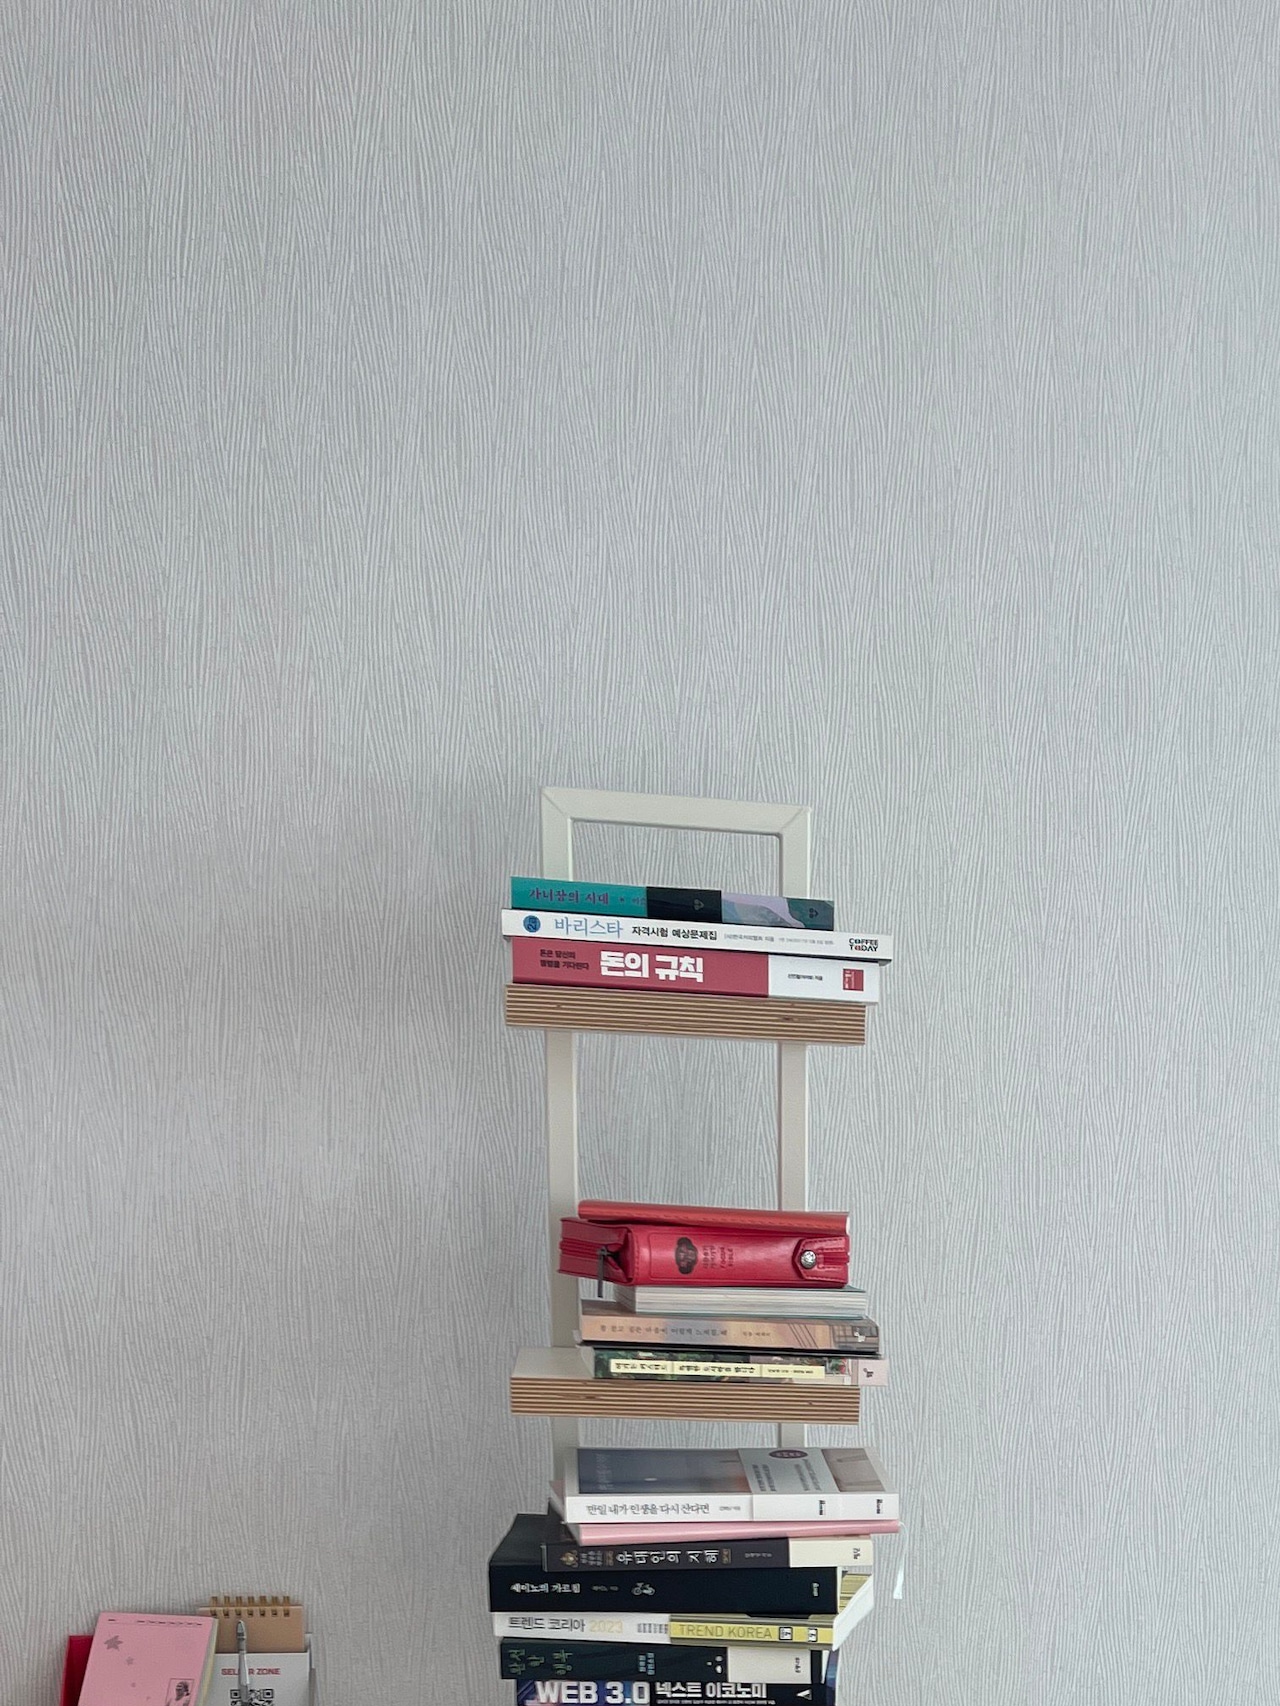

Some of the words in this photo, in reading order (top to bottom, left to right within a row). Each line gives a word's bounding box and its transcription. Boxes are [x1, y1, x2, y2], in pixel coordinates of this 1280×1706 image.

[585, 891, 610, 905] 시대
[554, 916, 624, 939] 바리스타
[632, 926, 669, 938] 자격시험
[672, 928, 718, 941] 예상문제집
[849, 937, 879, 946] COFFEE
[849, 944, 878, 952] TODAY
[600, 950, 650, 979] 돈의
[654, 954, 704, 982] 규칙
[586, 1504, 608, 1516] 만일
[609, 1503, 629, 1516] 내가
[630, 1503, 659, 1516] 인생을
[660, 1503, 680, 1516] 다시
[681, 1503, 710, 1515] 산다면
[616, 1550, 682, 1565] 유대인의
[686, 1549, 720, 1564] 지혜
[510, 1582, 550, 1594] 세이노의
[508, 1616, 546, 1631] 트렌드
[548, 1618, 586, 1633] 코리아
[589, 1619, 624, 1634] 2023
[679, 1623, 724, 1638] TREND
[728, 1625, 773, 1639] KOREA
[221, 1668, 255, 1676] SELR
[535, 1680, 599, 1704] WEB
[604, 1680, 650, 1705] 3.0
[654, 1681, 702, 1698] 넥스트
[705, 1682, 768, 1699] 이코노미
